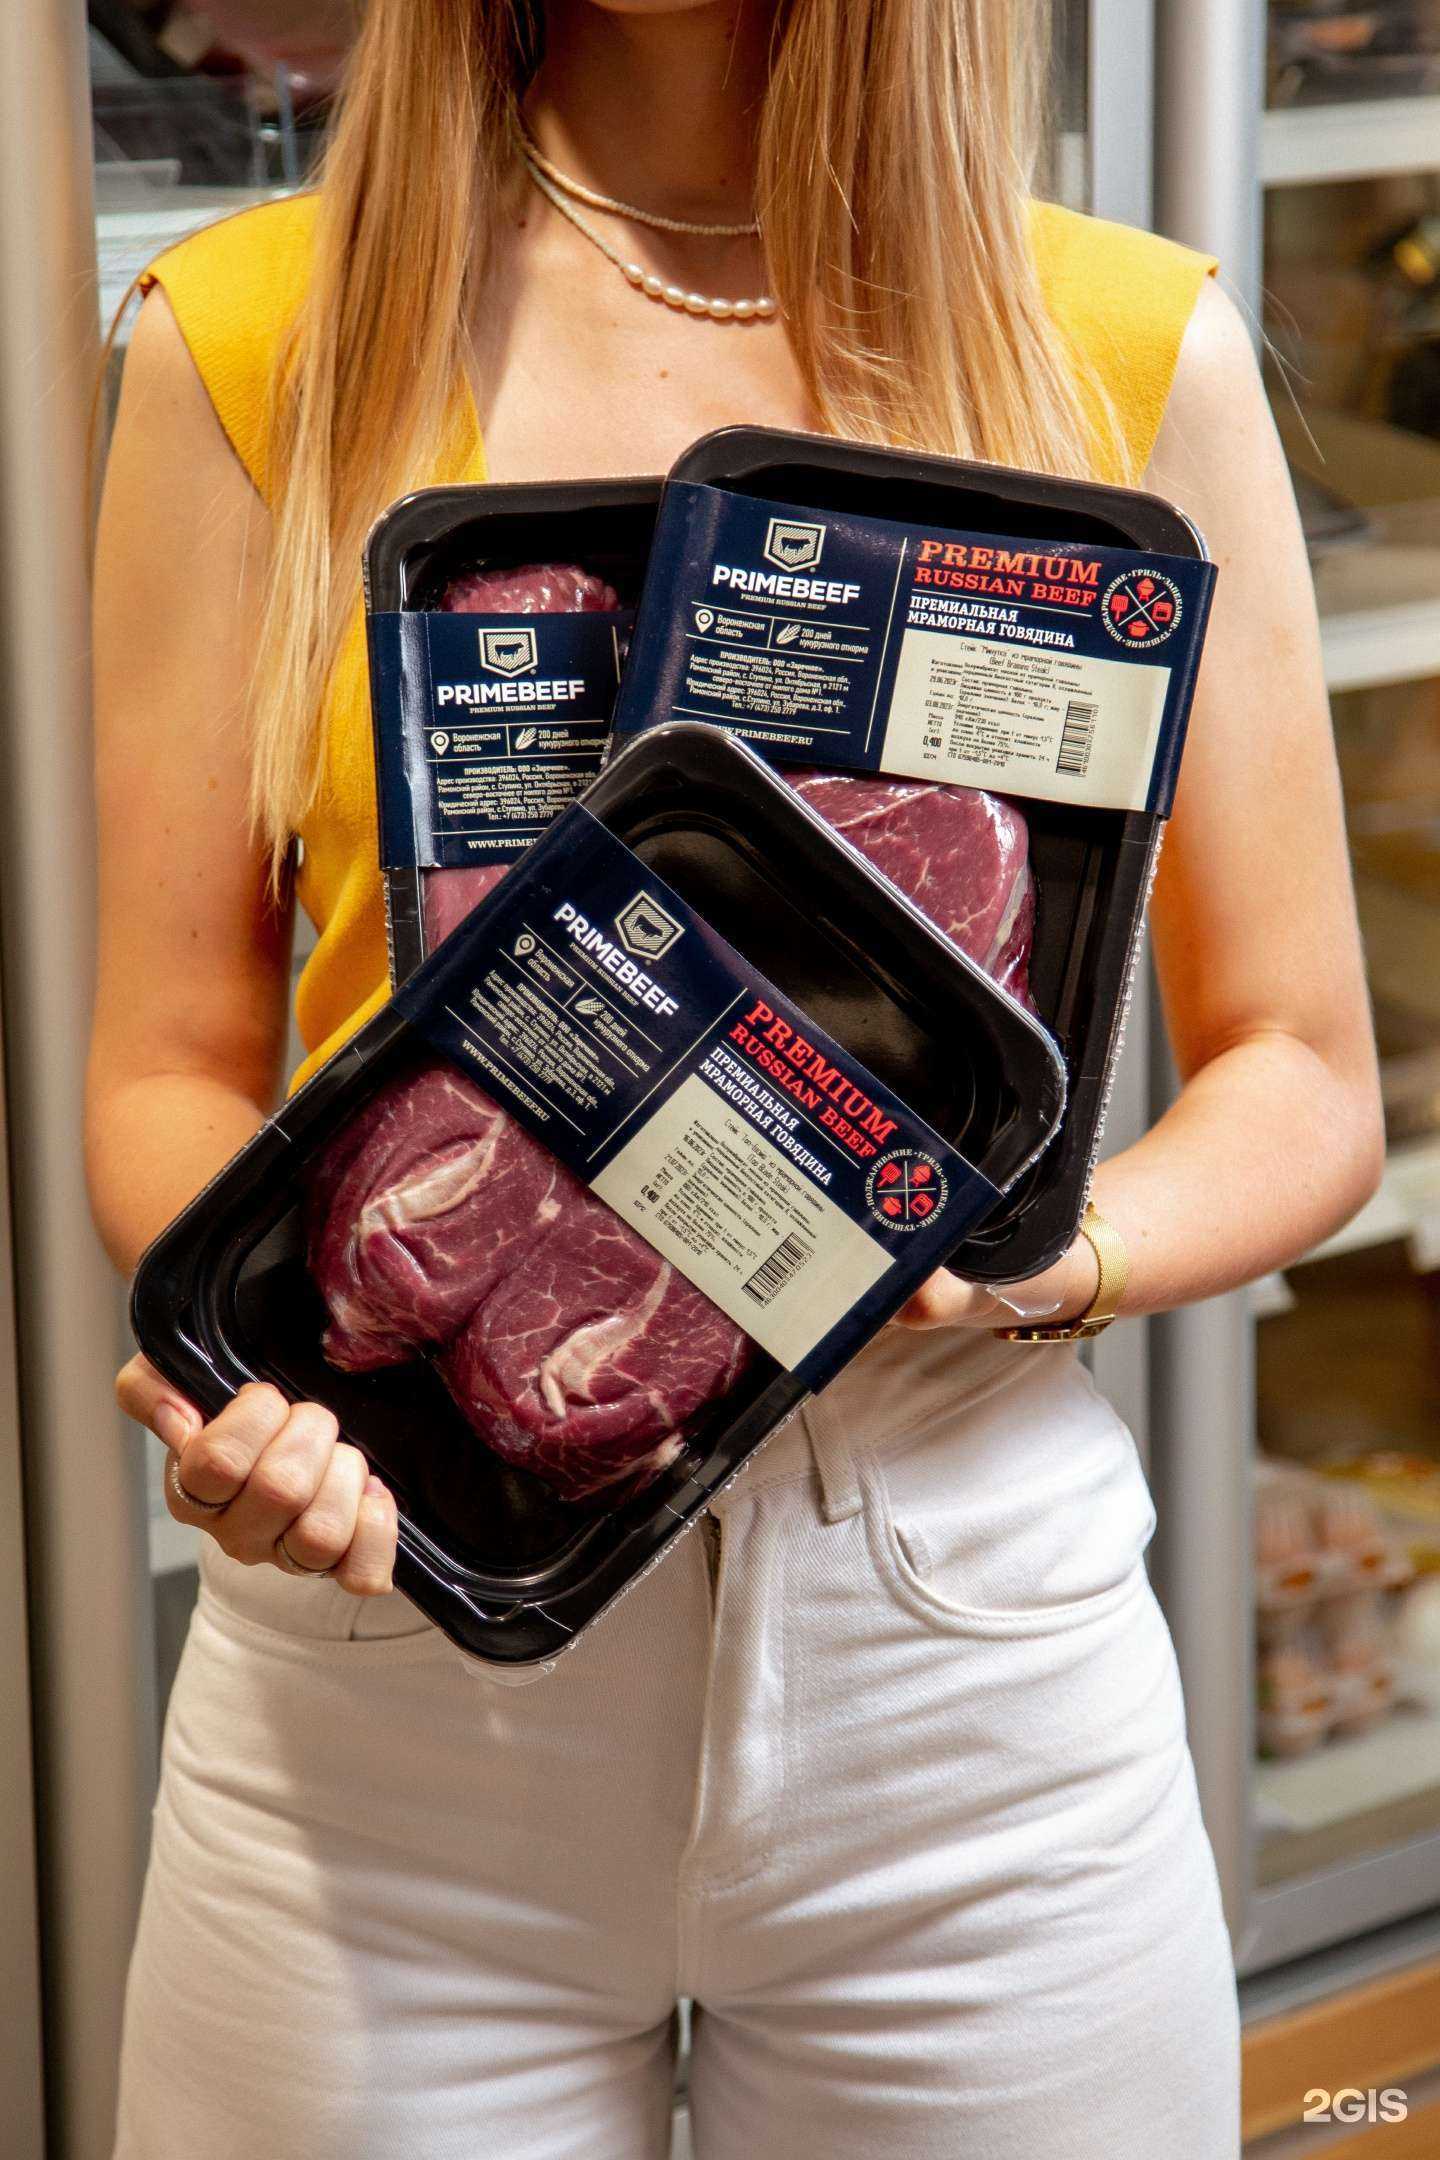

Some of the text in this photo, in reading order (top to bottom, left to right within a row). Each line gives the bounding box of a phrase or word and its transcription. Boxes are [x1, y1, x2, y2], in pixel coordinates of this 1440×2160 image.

[917, 538, 1101, 586] PREMIUM
[712, 564, 860, 606] PRIMEBEEF
[914, 565, 1096, 608] RUSSIAN BEEF
[716, 614, 765, 631] Воронежская
[907, 609, 1075, 649] МРАМОРНАЯ ГОВЯДИНА
[909, 595, 1018, 623] ПРЕМИАЛЬНАЯ
[715, 625, 744, 637] область
[801, 628, 832, 641] 200 дней
[437, 679, 585, 706] PRIMEBEEF
[526, 957, 552, 982] область
[534, 948, 576, 988] Воронежская
[552, 901, 679, 1022] PRIMEBEEF
[599, 1010, 628, 1038] 200 дней
[460, 1039, 550, 1123] WWW.PRIMEBEEF.RU
[708, 1045, 800, 1131] ПРЕМИАЛЬНАЯ
[727, 1022, 878, 1162] RUSSIAN BEEF
[742, 999, 899, 1145] PREMIUM
[697, 1057, 774, 1130] МРАМОРНАЯ
[768, 1123, 835, 1187] ГОВЯДИНА
